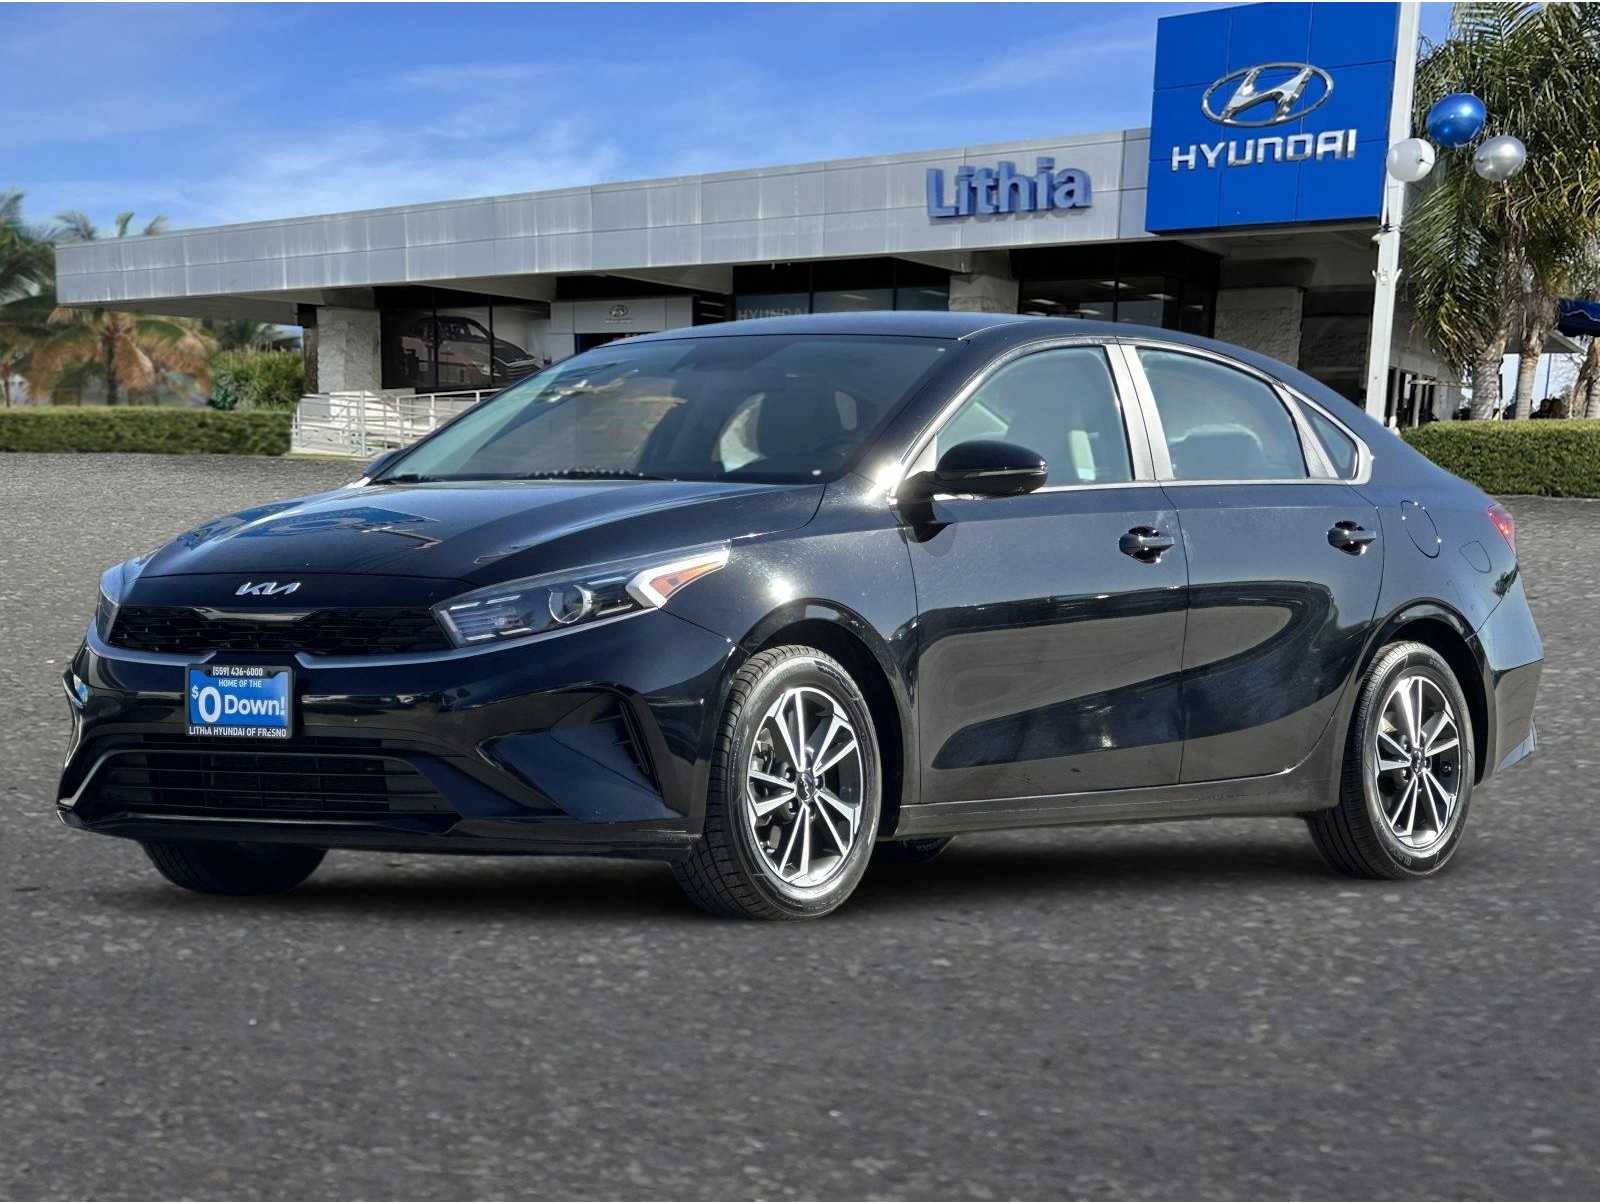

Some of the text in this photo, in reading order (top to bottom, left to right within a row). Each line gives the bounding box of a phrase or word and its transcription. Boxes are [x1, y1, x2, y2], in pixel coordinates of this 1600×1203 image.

[1171, 128, 1357, 172] HYUNDAI
[927, 157, 1092, 217] Lithia
[235, 582, 300, 595] KIA
[212, 665, 264, 677] (559) 436-6000
[218, 679, 262, 688] HOME OF THE
[224, 694, 286, 716] Down!
[189, 726, 212, 735] LITHIA
[213, 726, 245, 736] HYUNDAI
[246, 727, 256, 737] OF
